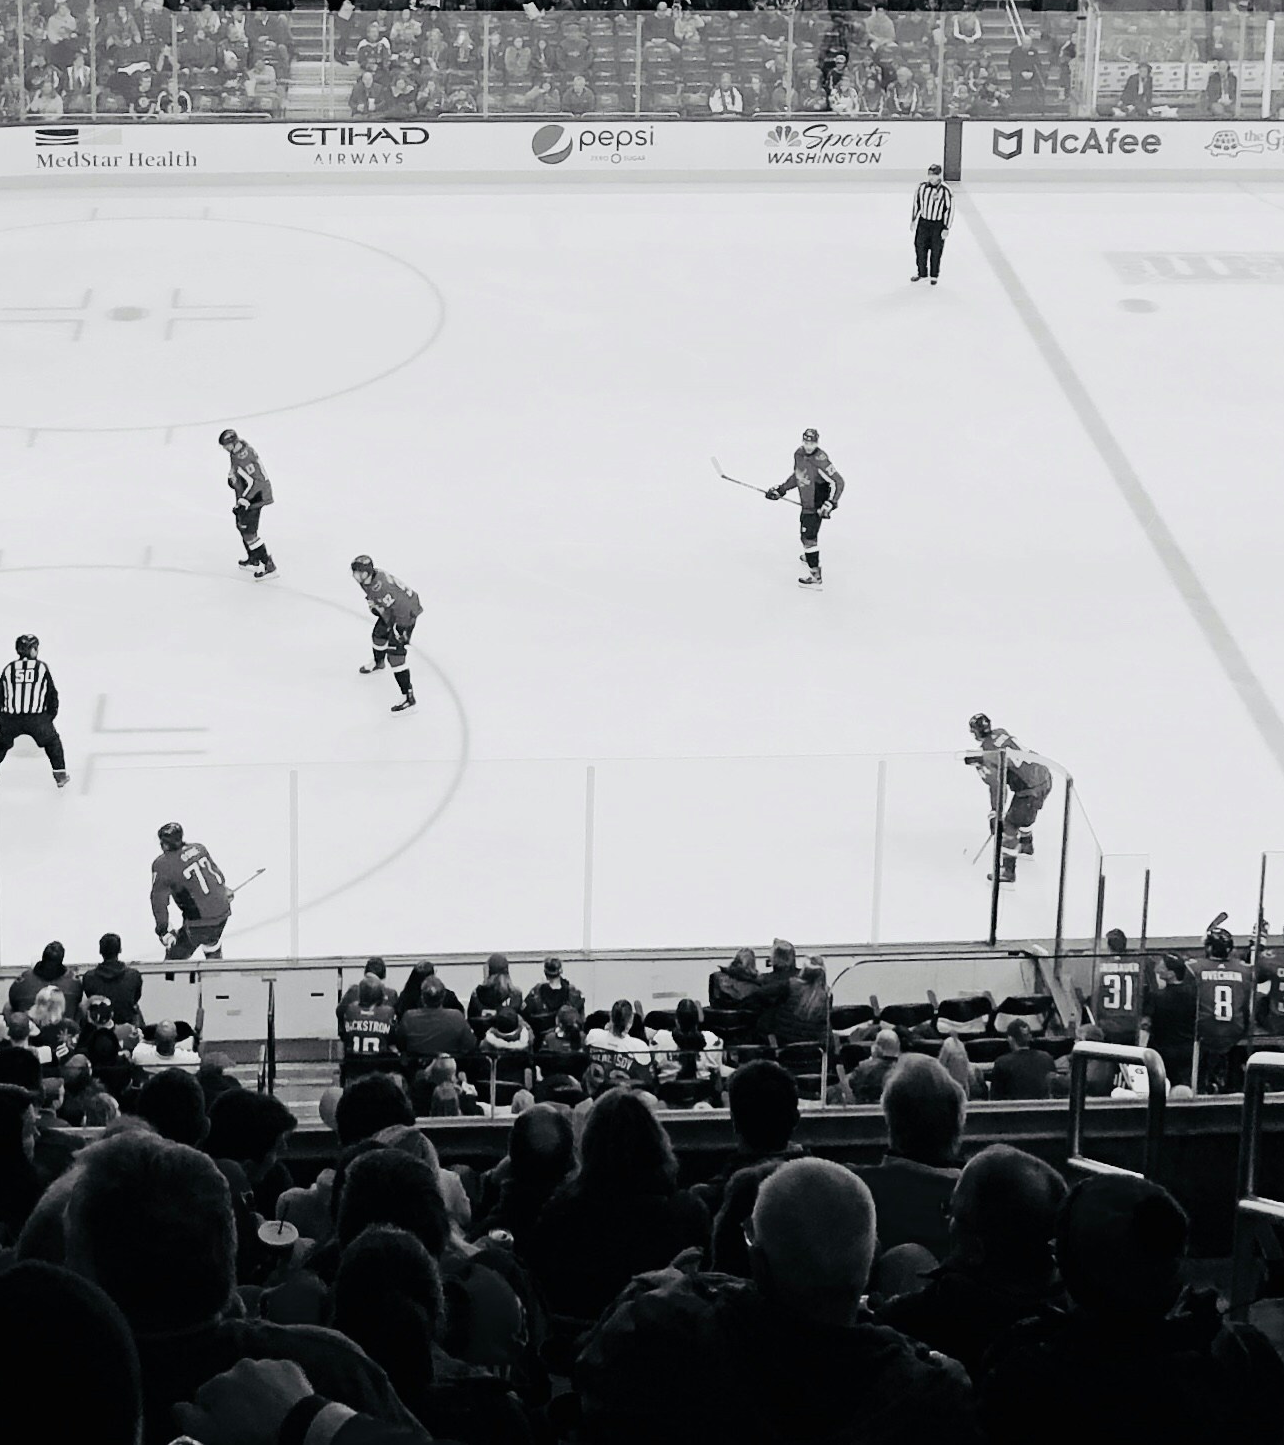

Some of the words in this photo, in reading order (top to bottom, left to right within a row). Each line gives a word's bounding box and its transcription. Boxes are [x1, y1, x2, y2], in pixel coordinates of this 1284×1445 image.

[288, 127, 430, 146] ETIHAD
[579, 125, 655, 152] pepsi
[801, 123, 890, 150] Sports
[1034, 127, 1162, 155] McAfee
[1244, 130, 1264, 142] the
[36, 152, 124, 169] MedStar
[129, 151, 197, 168] Health
[314, 152, 403, 165] AIRWAYS
[767, 152, 882, 165] WASHINGTON
[15, 669, 35, 683] 50
[183, 856, 224, 896] 77
[1104, 975, 1133, 1010] 31
[1214, 985, 1233, 1022] 8
